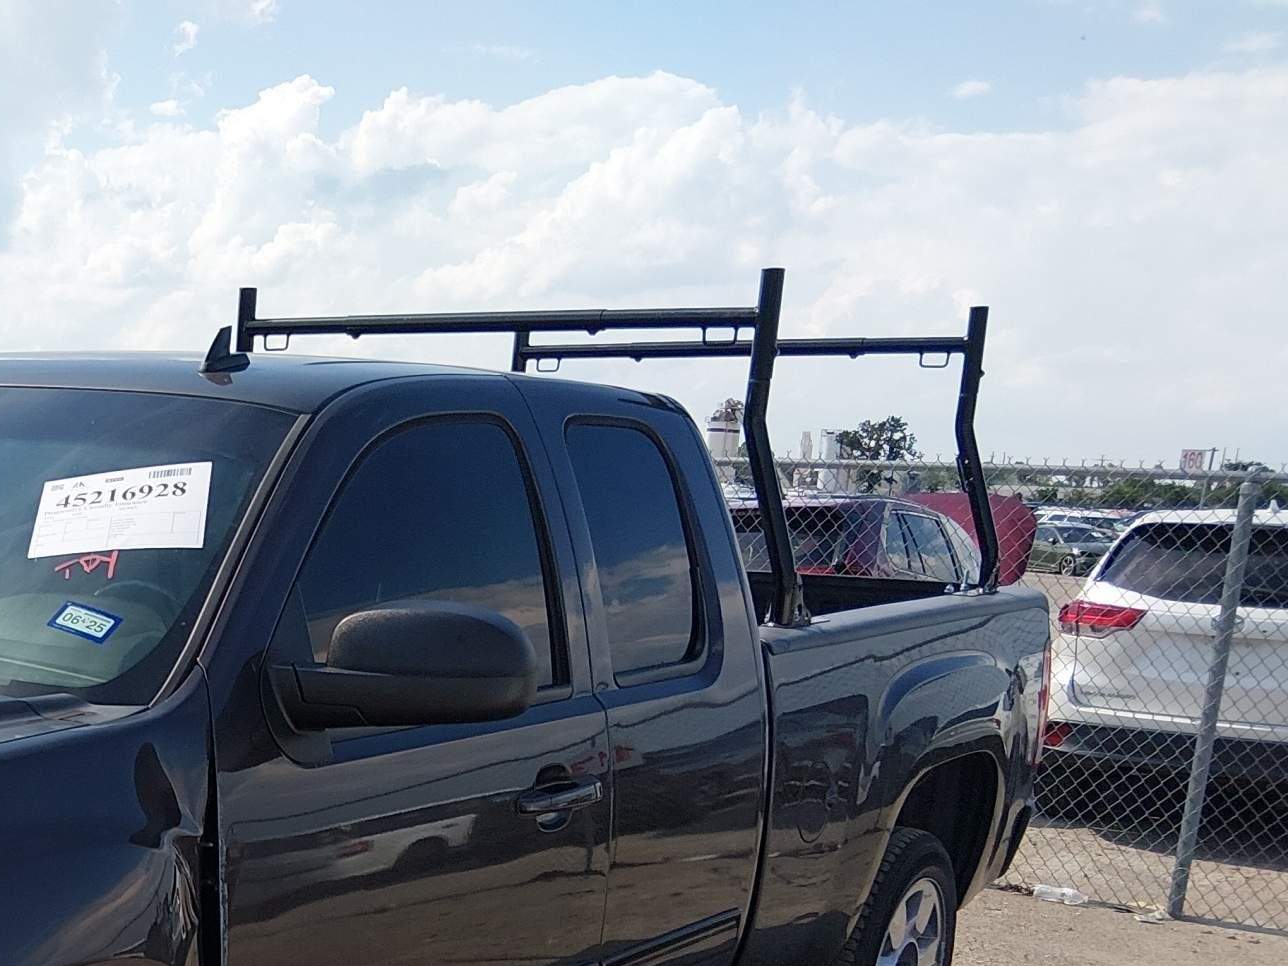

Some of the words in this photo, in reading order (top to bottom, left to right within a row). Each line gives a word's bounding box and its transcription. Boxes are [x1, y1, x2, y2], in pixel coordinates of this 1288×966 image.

[55, 481, 188, 508] 45216928
[62, 612, 83, 625] 06
[85, 620, 107, 633] 25
